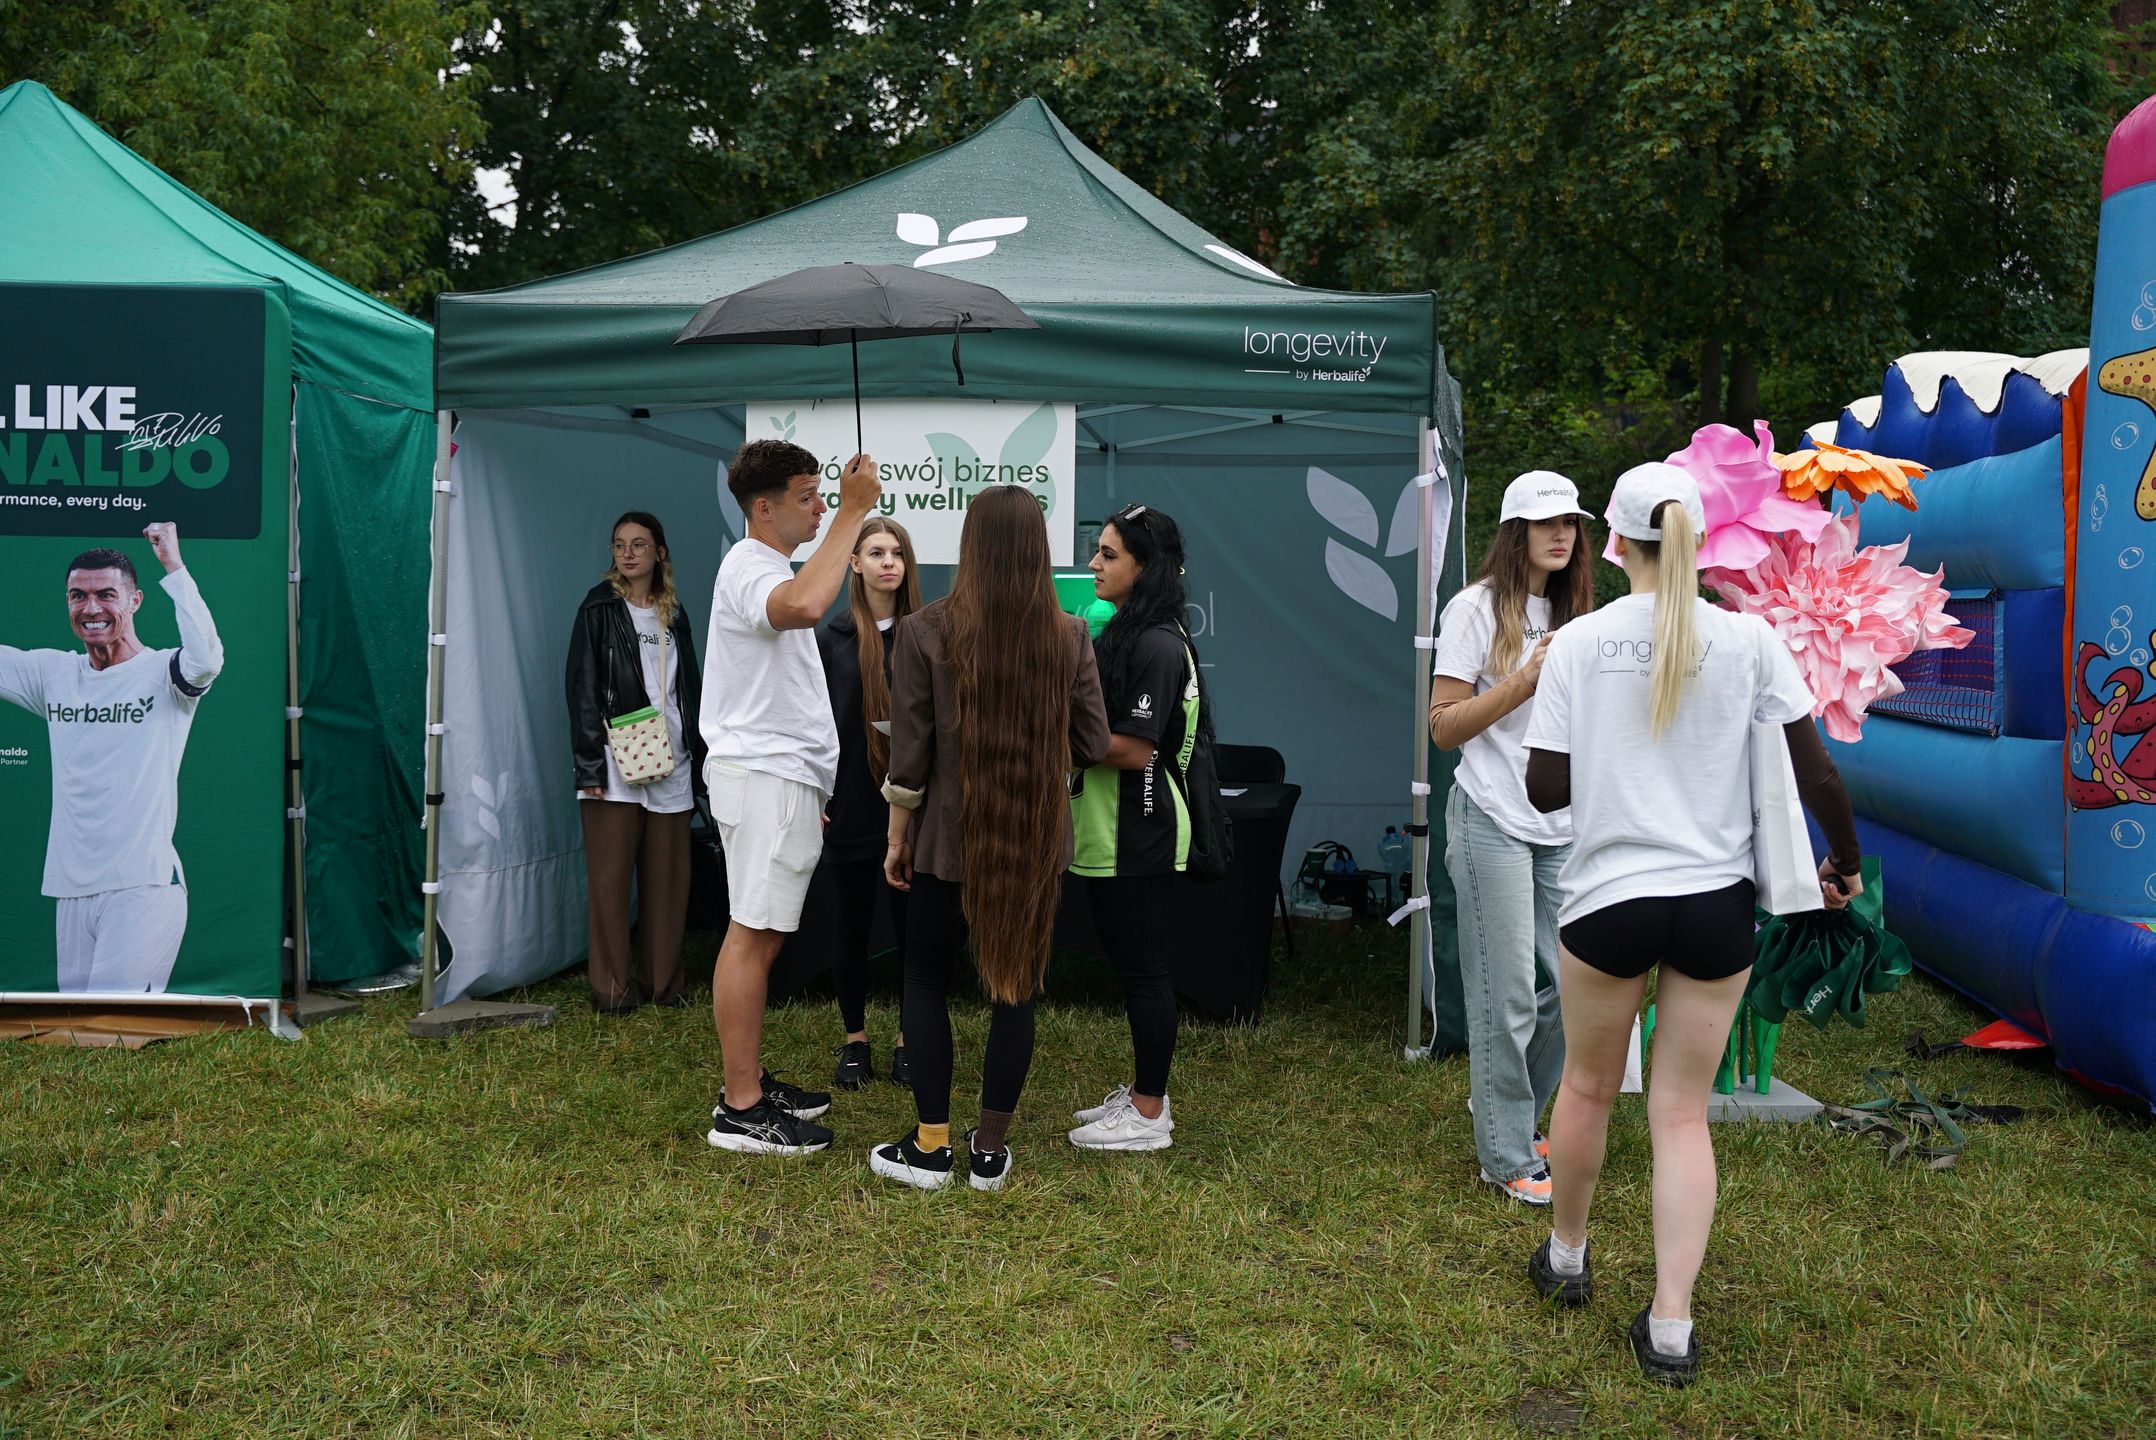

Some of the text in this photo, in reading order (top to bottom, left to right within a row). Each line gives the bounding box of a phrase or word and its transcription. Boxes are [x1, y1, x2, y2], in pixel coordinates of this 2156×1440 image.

[1244, 326, 1387, 364] longevity
[1296, 368, 1366, 382] by Herbalife
[15, 384, 136, 431] LIKE
[879, 457, 943, 489] swój
[955, 458, 1049, 483] biznes
[66, 496, 108, 510] every
[112, 493, 147, 511] day.
[905, 486, 1049, 512] wellns
[1597, 635, 1712, 663] longy
[48, 702, 145, 724] Herbalife
[1, 757, 28, 765] Partner
